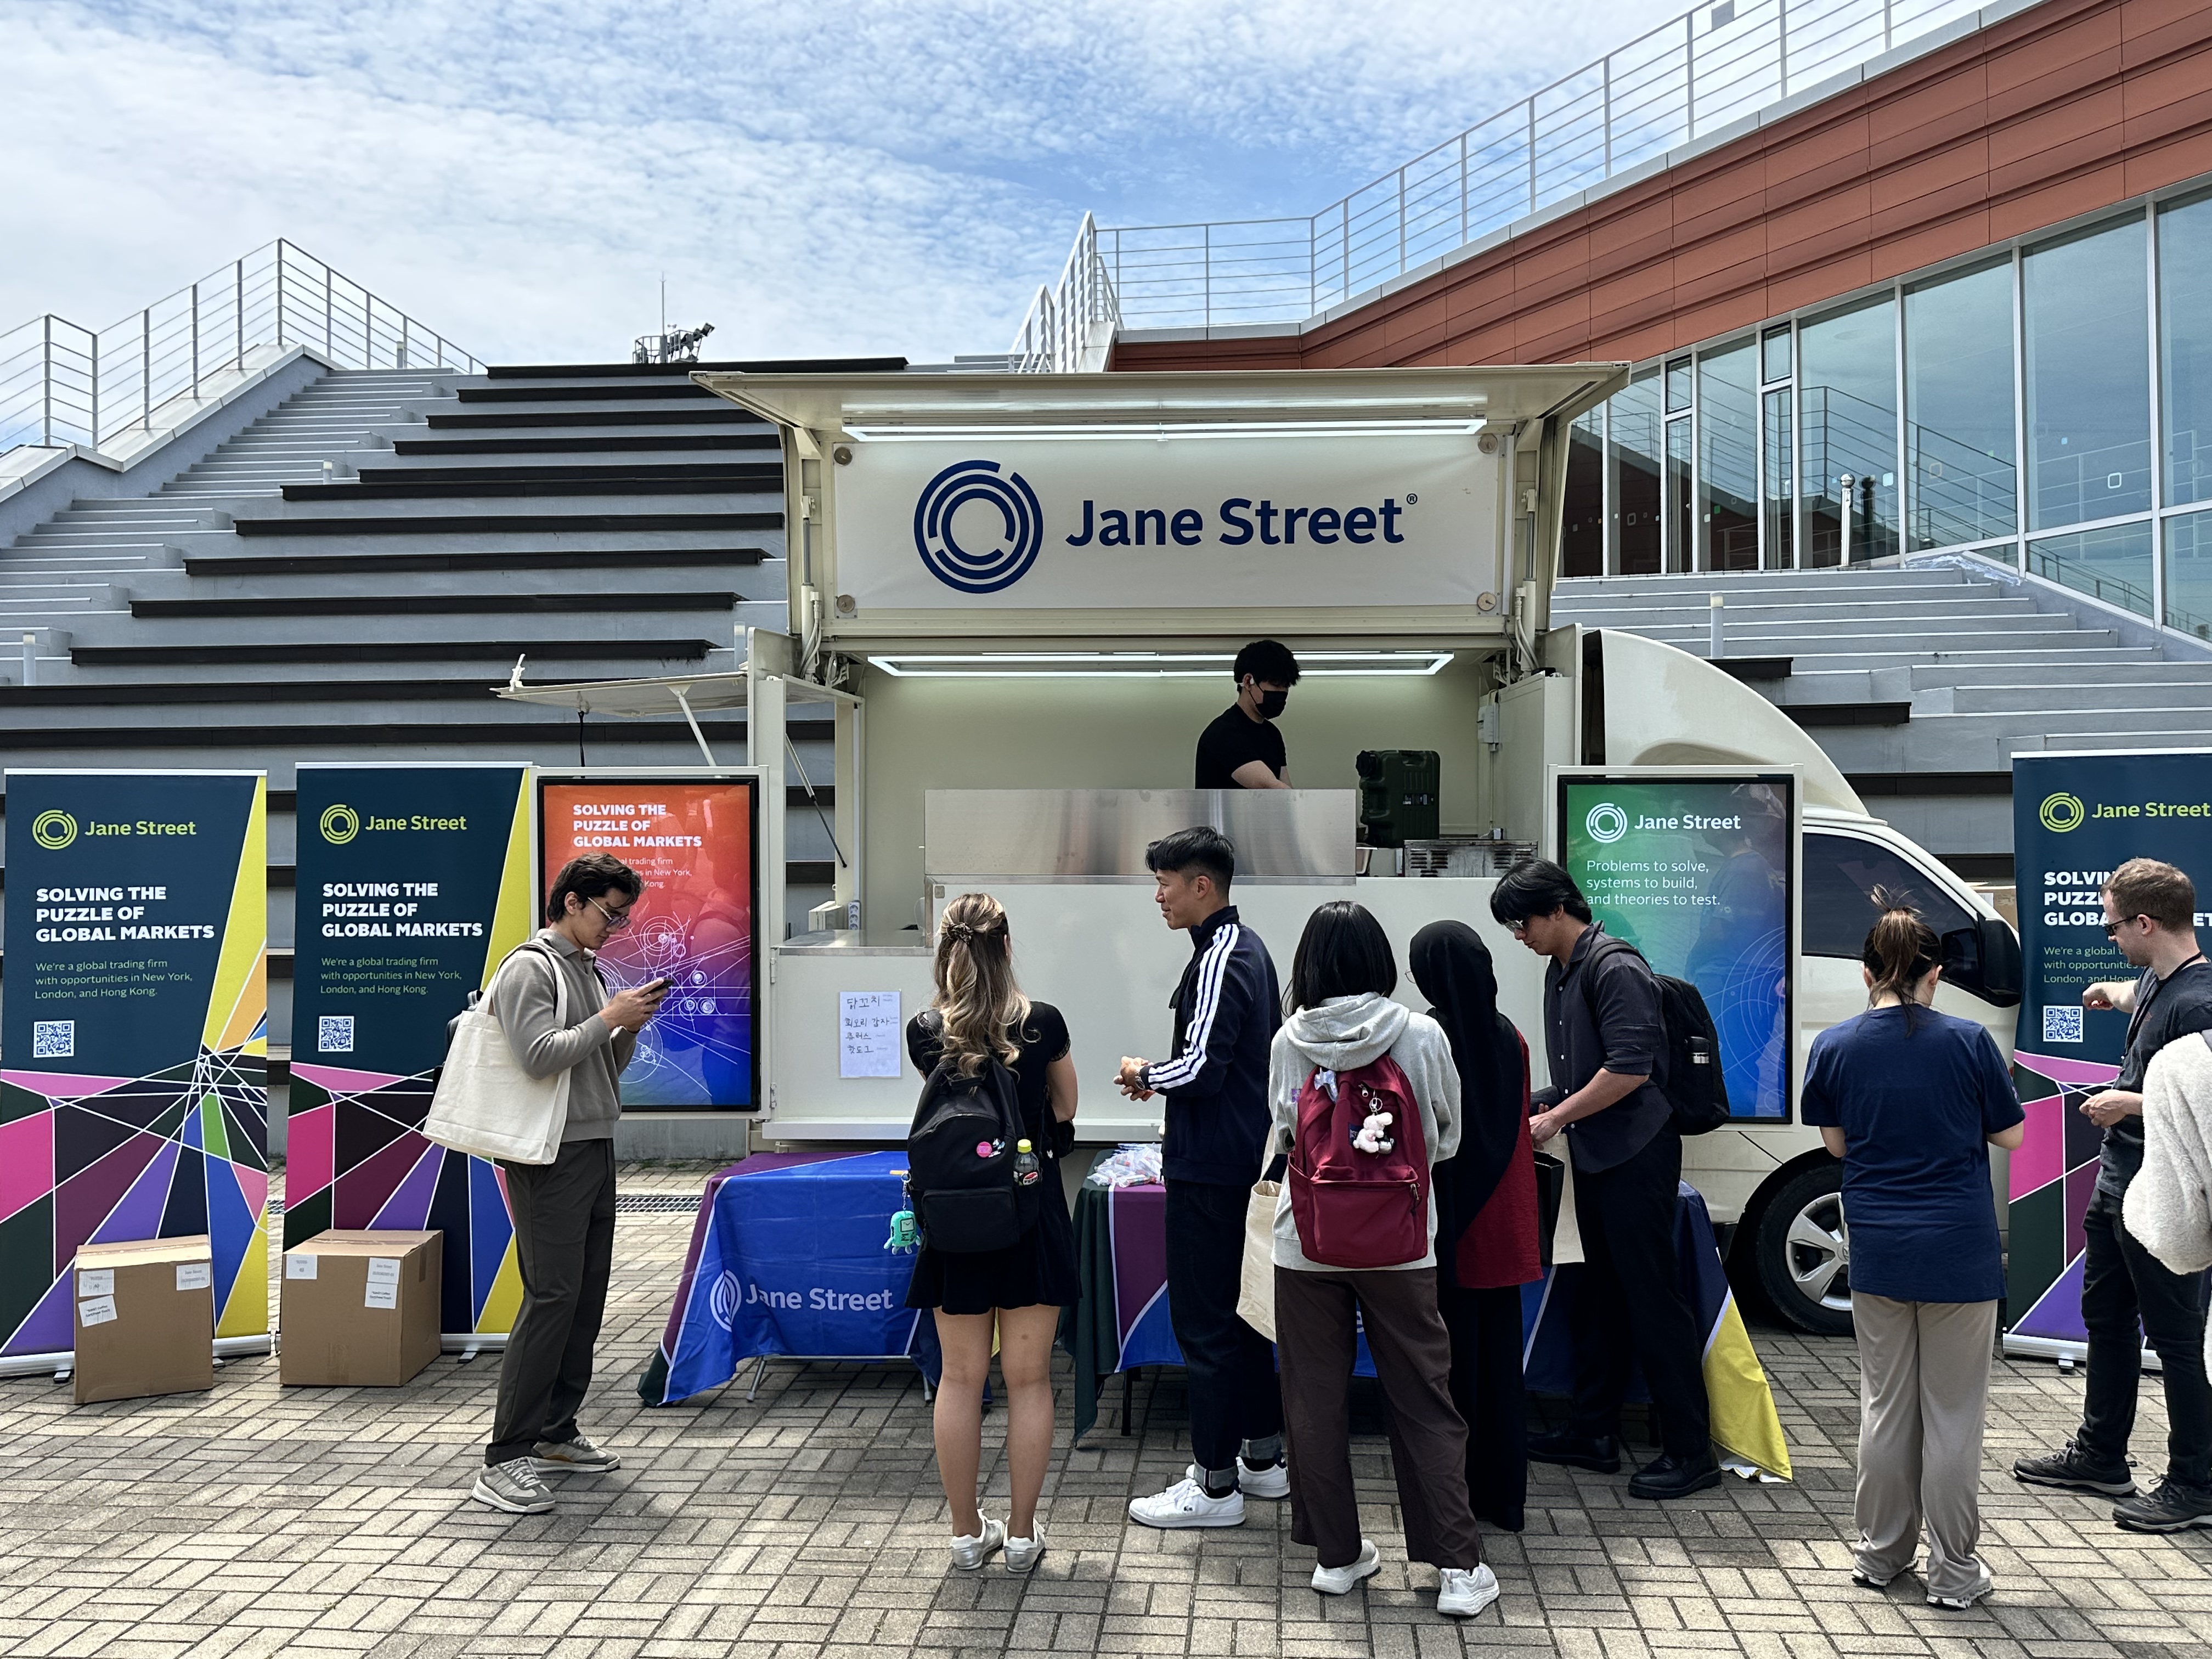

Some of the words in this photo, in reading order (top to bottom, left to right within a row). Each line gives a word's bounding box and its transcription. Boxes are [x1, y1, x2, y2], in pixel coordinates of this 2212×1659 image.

[1066, 500, 1203, 546] Jane
[573, 805, 635, 815] SOLVING
[639, 805, 665, 815] THE
[2092, 803, 2140, 818] Jane
[2146, 802, 2211, 817] Street
[85, 821, 131, 836] Jane
[136, 821, 196, 835] Street
[365, 816, 407, 831] Jane
[410, 816, 467, 830] Street
[574, 821, 628, 831] PUZZLE
[631, 820, 650, 831] OF
[1634, 815, 1679, 830] Jane
[1683, 815, 1741, 830] Street
[573, 837, 630, 847] GLOBAL
[634, 836, 702, 847] MARKETS
[629, 857, 655, 866] trading
[1587, 861, 1649, 872] Problems
[1654, 862, 1668, 872] to
[1672, 861, 1709, 873] solve,
[1587, 878, 1641, 890] systems
[1645, 878, 1658, 888] to
[1662, 877, 1698, 890] build,
[2044, 872, 2115, 885] SOLVI
[37, 888, 123, 901] SOLVING
[128, 887, 166, 900] THE
[323, 883, 399, 897] SOLVING
[403, 883, 438, 896] THE
[1587, 894, 1611, 905] and
[1615, 894, 1669, 905] theories
[1673, 895, 1687, 905] to
[1691, 895, 1720, 905] test.
[2044, 892, 2104, 906] PUZZ
[37, 907, 113, 922] PUZZLE
[117, 907, 144, 920] OF
[323, 904, 389, 917] PUZZLE
[394, 904, 417, 916] OF
[2044, 912, 2108, 926] GLOBA
[36, 927, 116, 942] GLOBAL
[121, 925, 215, 940] MARKETS
[323, 923, 392, 937] GLOBAL
[396, 923, 482, 936] MARKETS
[2044, 946, 2073, 955] We're
[2085, 947, 2115, 957] global
[36, 962, 64, 971] We're
[77, 961, 107, 972] global
[110, 960, 145, 970] trading
[148, 959, 167, 967] firm
[321, 957, 347, 966] We're
[357, 957, 383, 968] global
[386, 957, 417, 968] trading
[420, 957, 438, 966] firm
[2044, 961, 2066, 969] with
[36, 975, 57, 985] with
[60, 974, 128, 985] opportunities
[143, 973, 164, 981] New
[168, 972, 193, 982] York,
[321, 971, 340, 980] with
[343, 971, 402, 982] opportunities
[405, 972, 413, 980] in
[415, 971, 436, 979] New
[438, 971, 462, 980] York,
[2044, 975, 2085, 983] London,
[35, 990, 76, 999] London,
[79, 989, 98, 998] and
[101, 988, 127, 998] Hong
[129, 987, 157, 997] Kong.
[320, 985, 356, 995] London,
[359, 985, 375, 994] and
[377, 985, 400, 995] Hong
[403, 985, 428, 995] Kong.
[872, 1017, 889, 1027] 감자
[847, 1045, 874, 1054] 핫도그
[746, 1284, 802, 1308] Jane
[809, 1288, 894, 1310] Street
